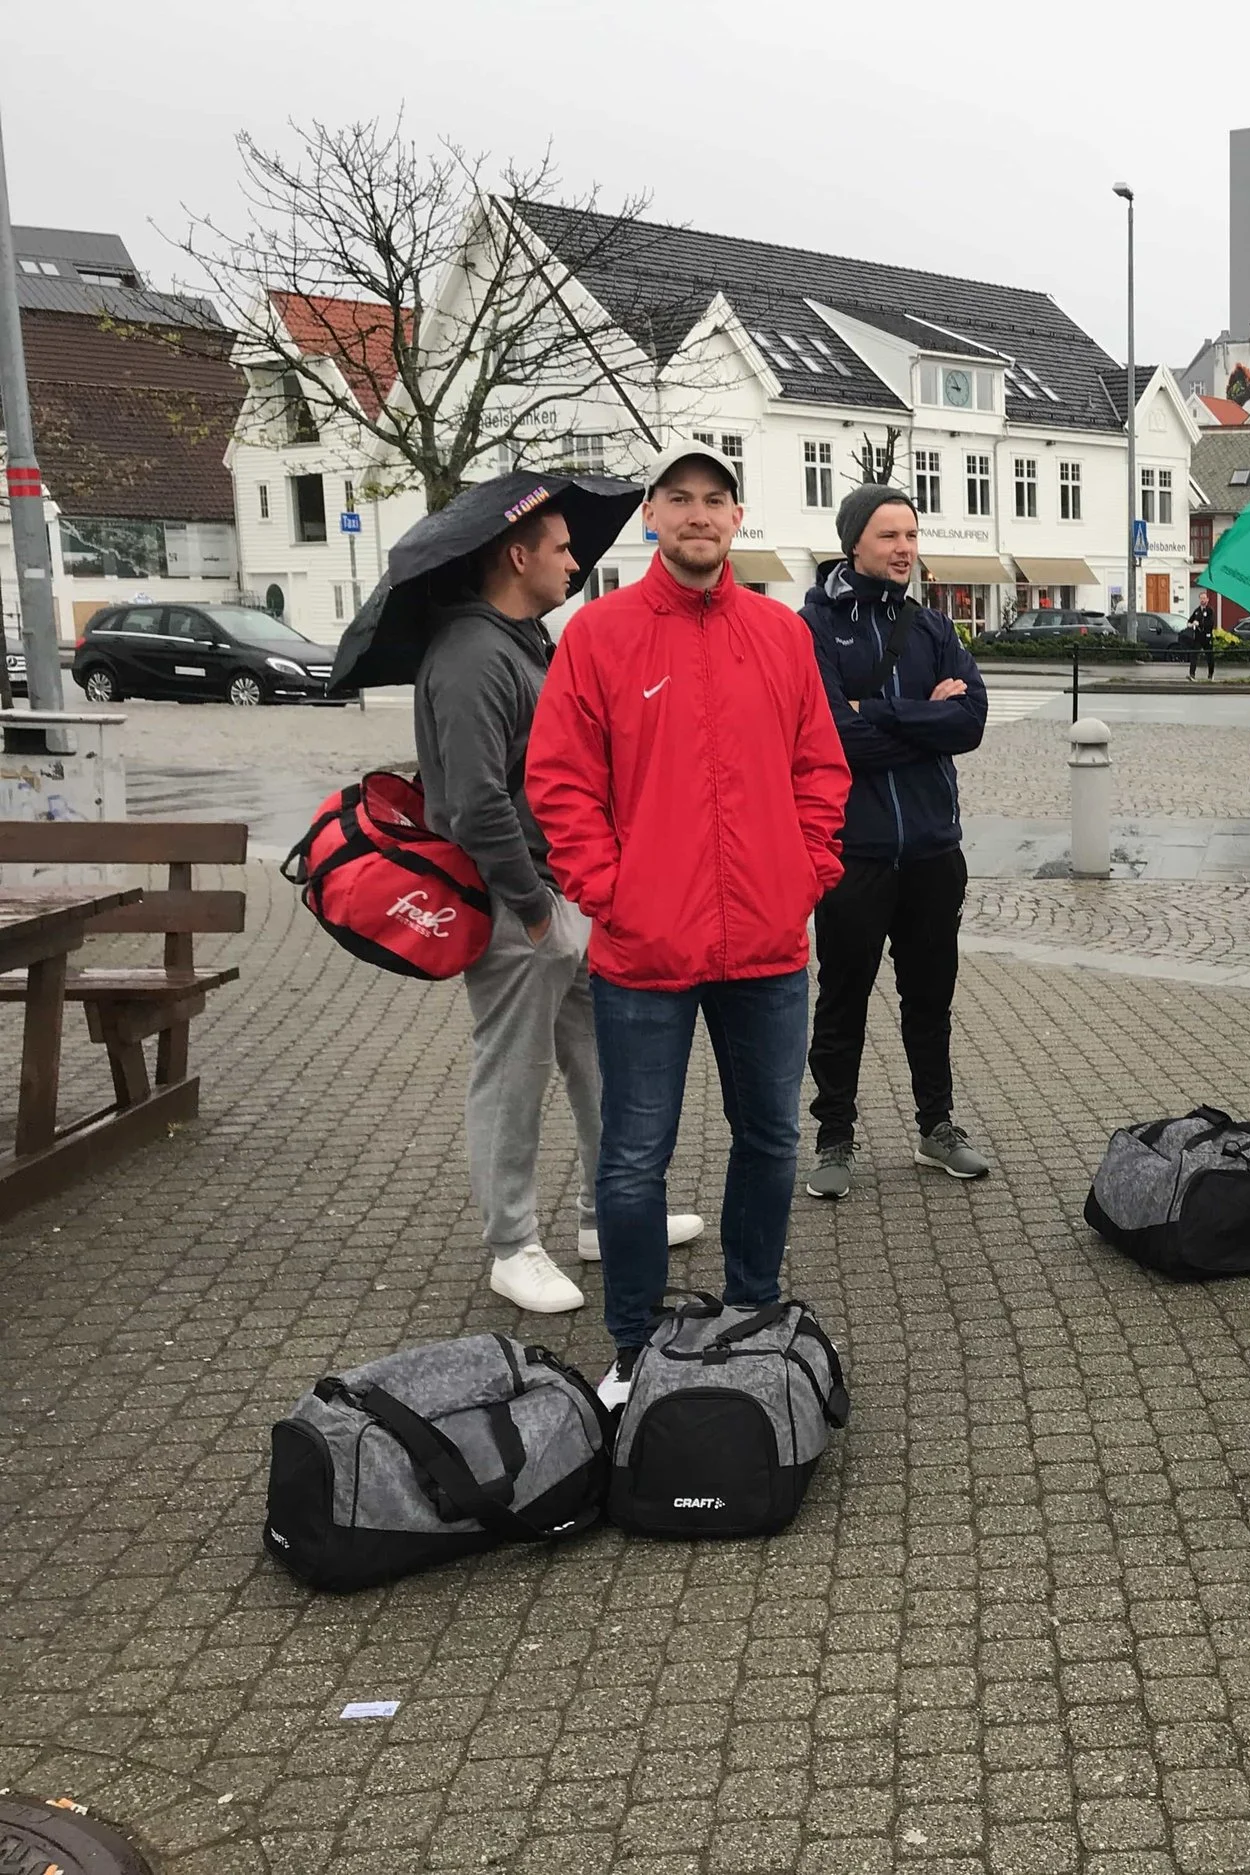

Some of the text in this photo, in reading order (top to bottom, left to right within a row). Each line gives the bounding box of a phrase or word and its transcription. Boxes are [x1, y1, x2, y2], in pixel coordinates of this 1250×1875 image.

[504, 485, 550, 523] STORM
[342, 514, 360, 529] Taxi
[386, 890, 457, 938] fresh
[673, 1497, 715, 1508] CRAFT
